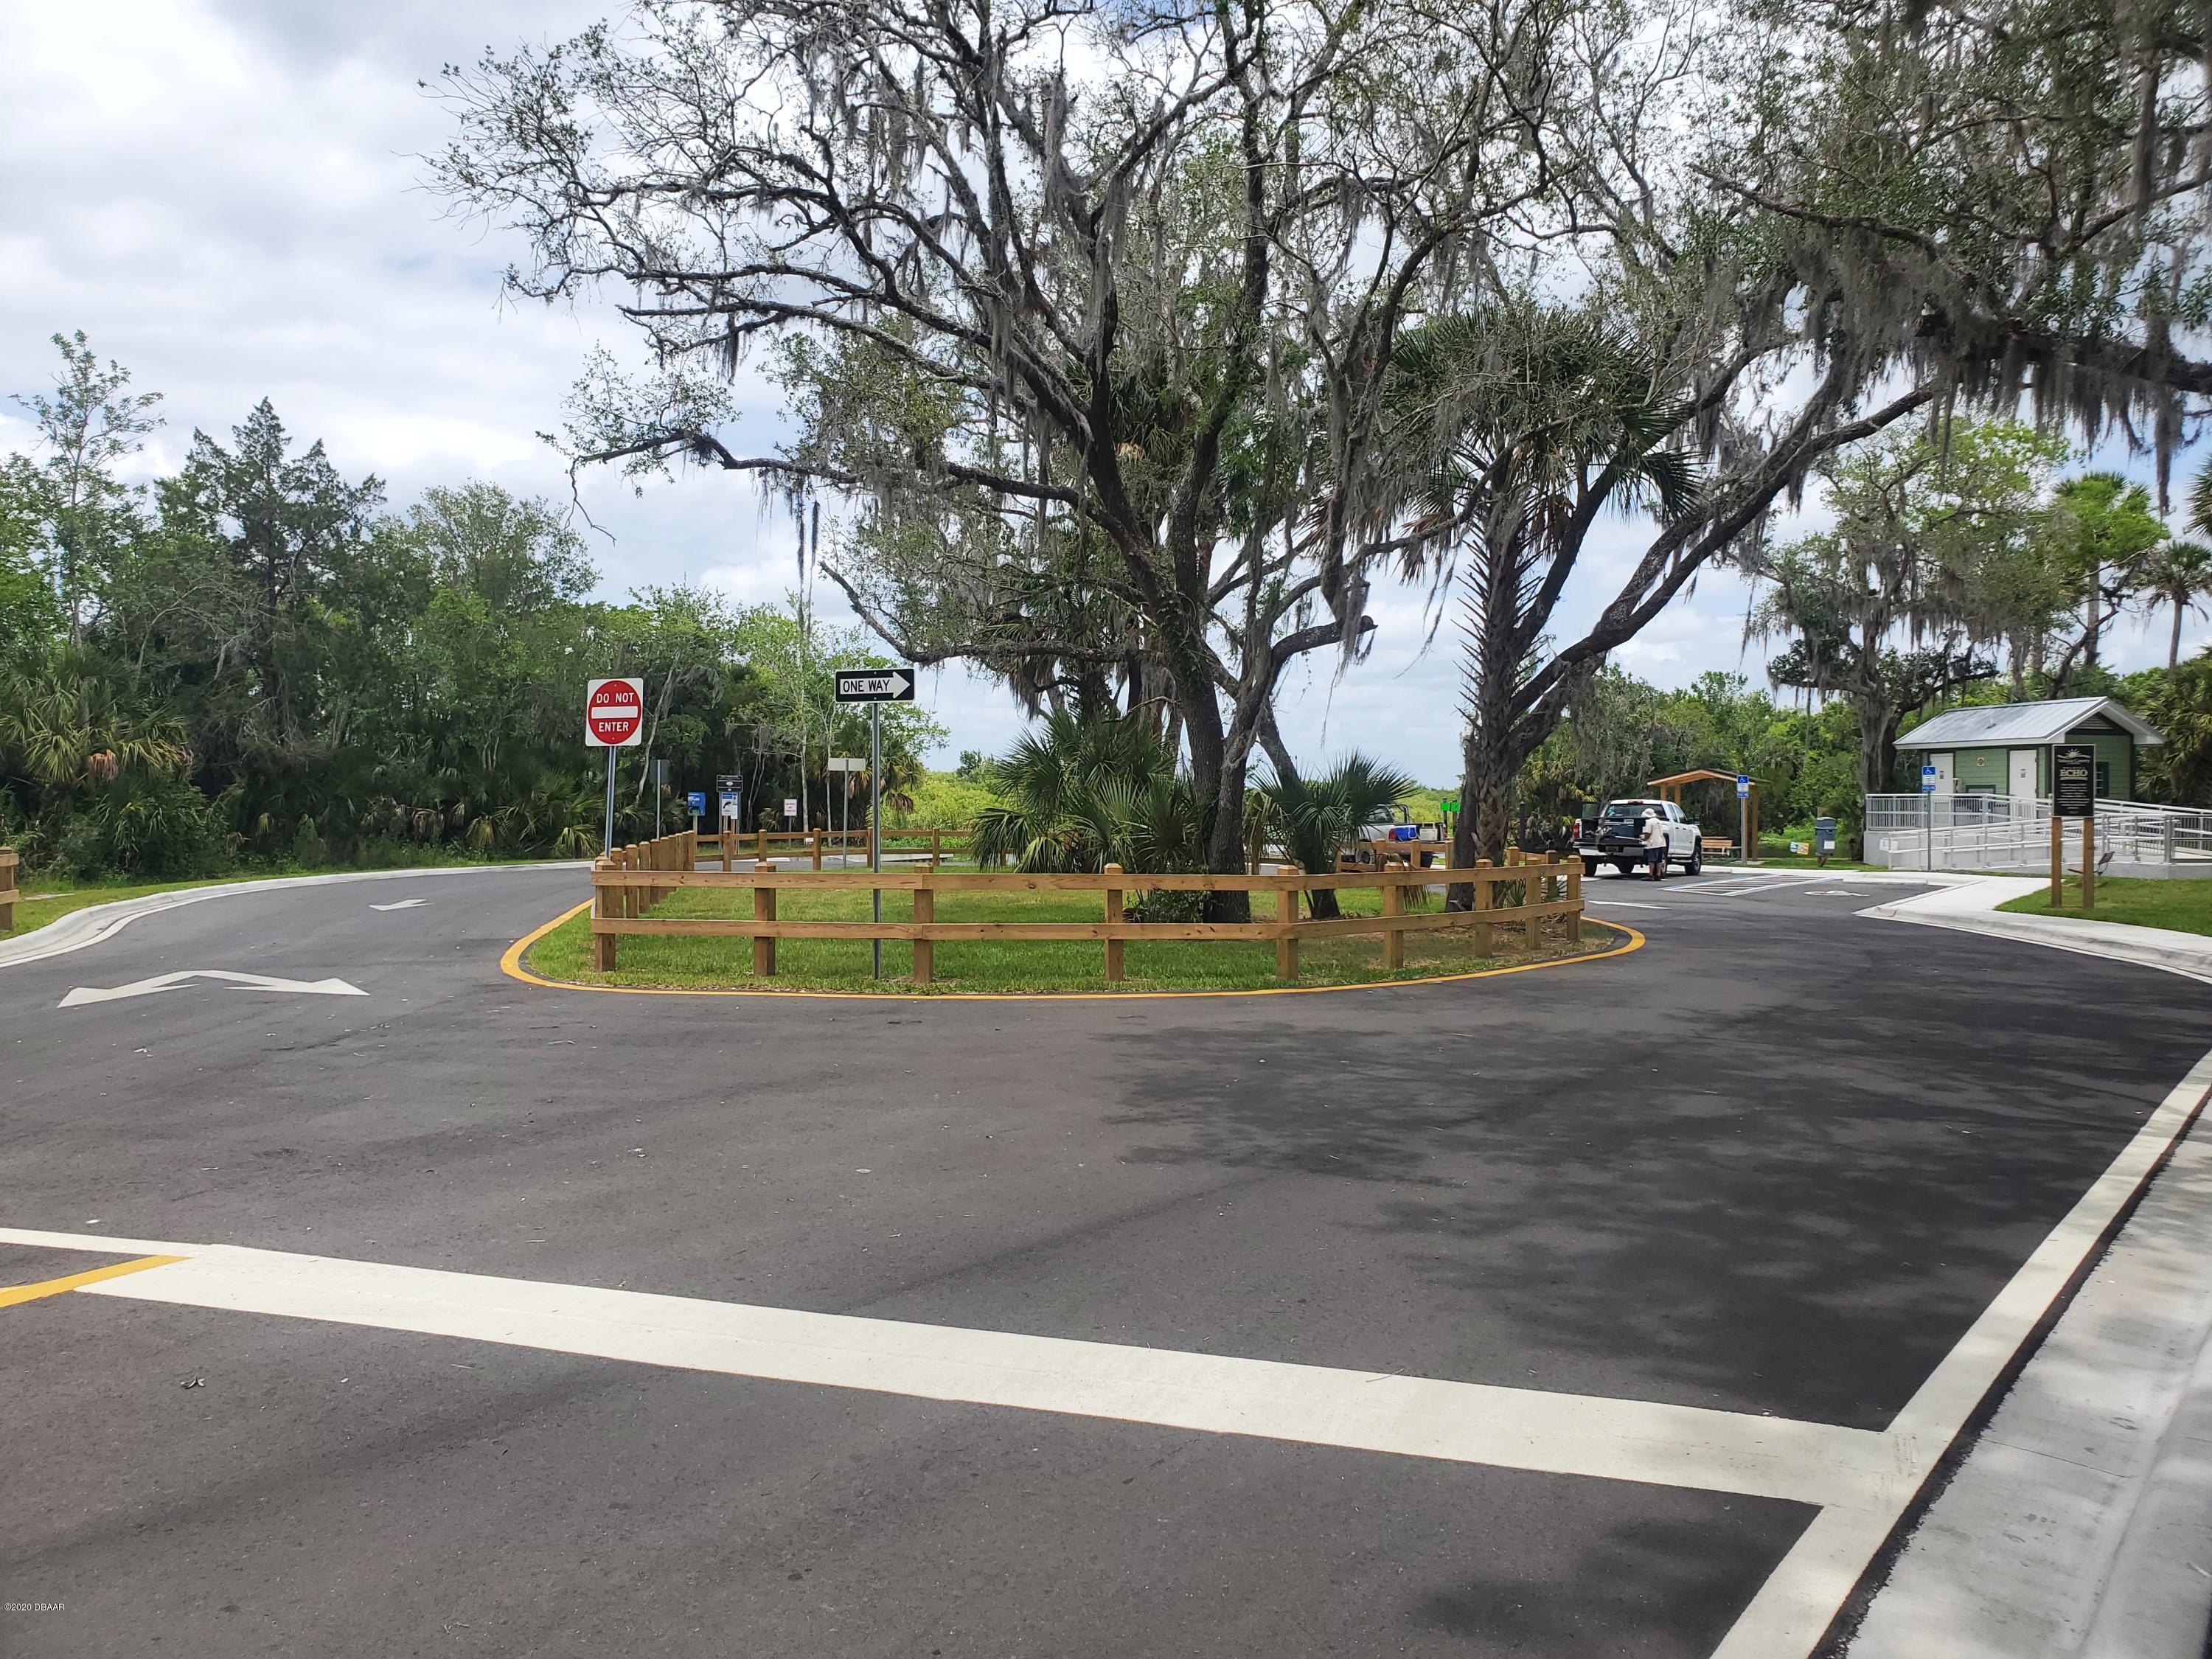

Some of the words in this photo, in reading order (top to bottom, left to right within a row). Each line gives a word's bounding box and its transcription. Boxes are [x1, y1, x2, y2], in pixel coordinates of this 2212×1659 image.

[843, 680, 864, 693] ONE
[868, 679, 890, 692] WAY
[596, 693, 610, 703] DO
[615, 692, 635, 703] NOT
[598, 721, 629, 732] ENTER
